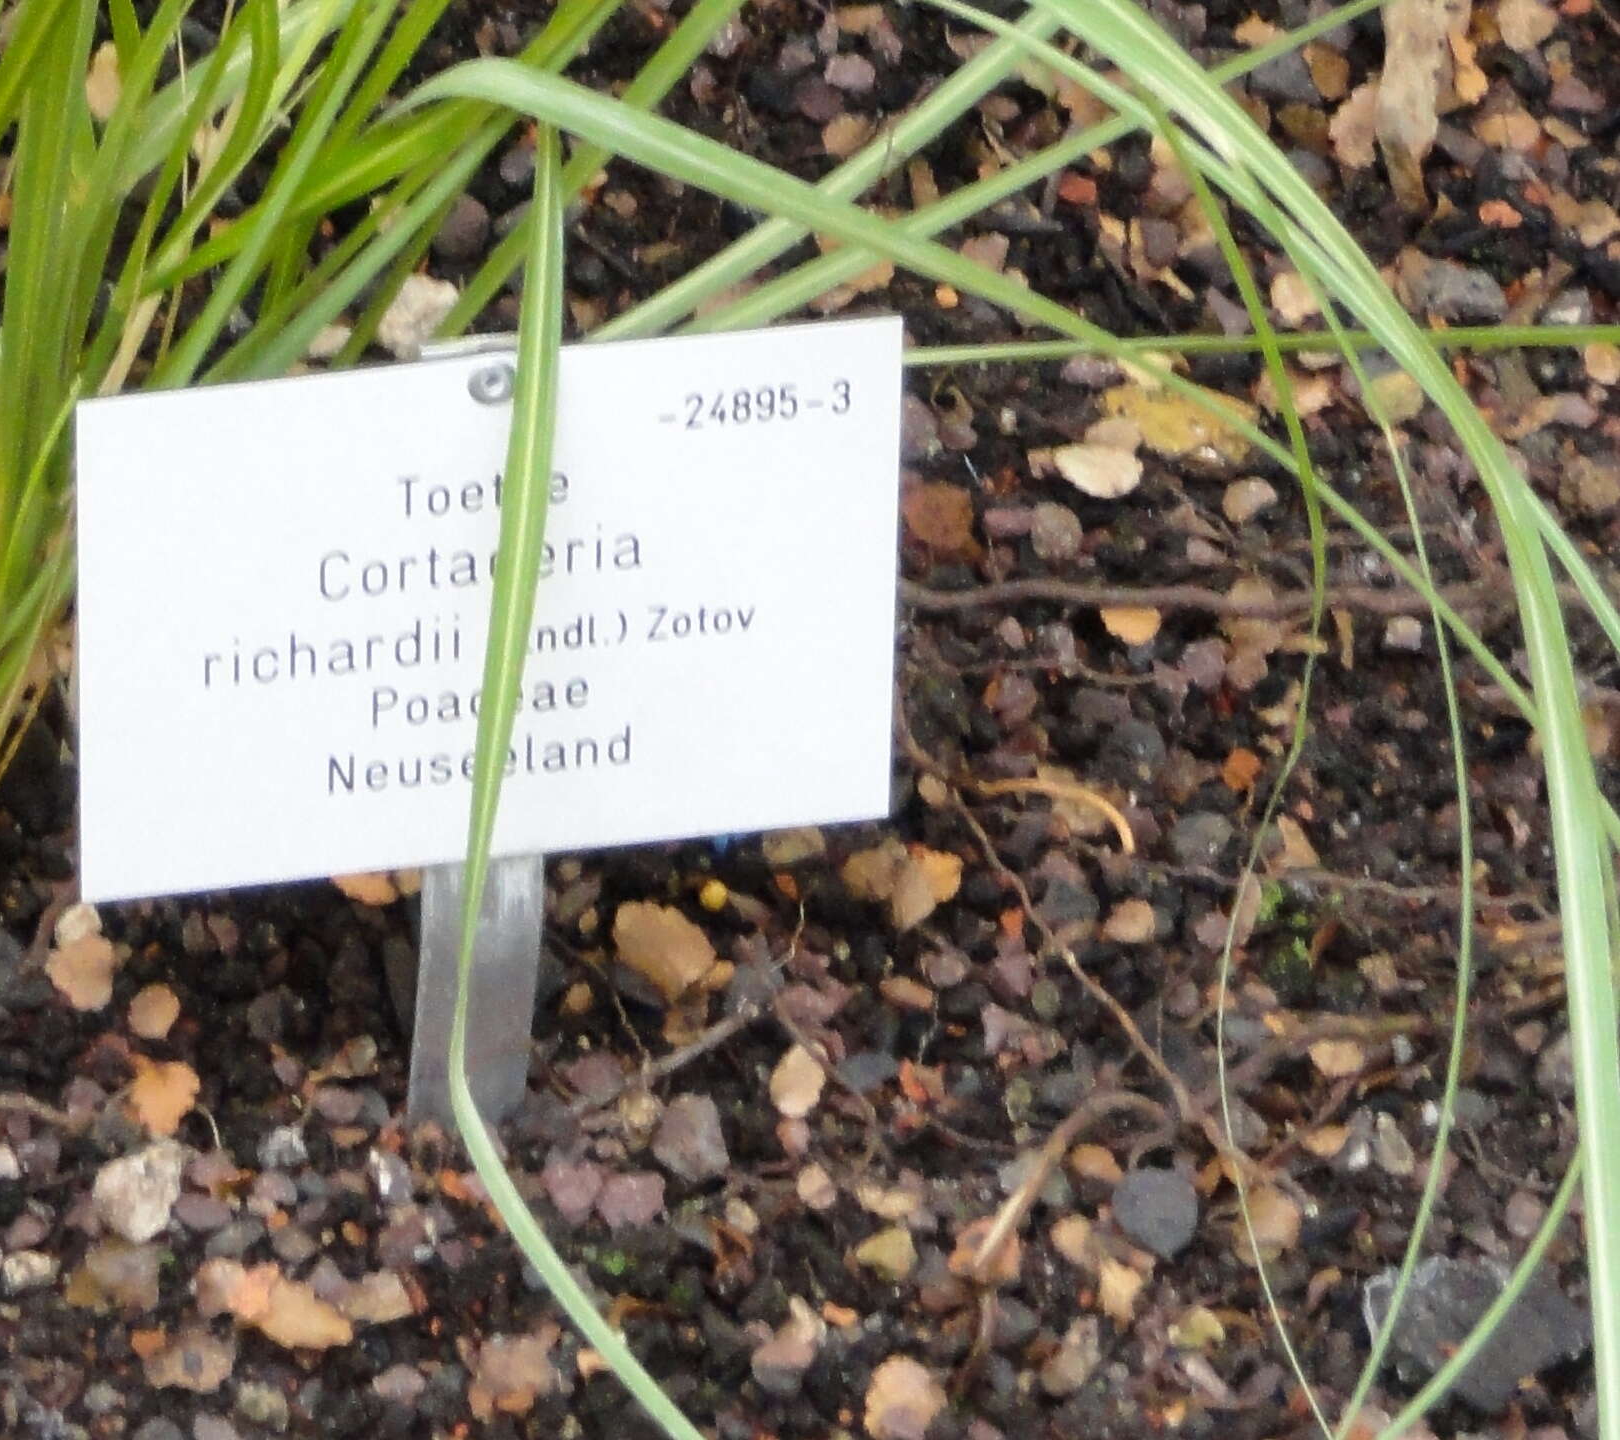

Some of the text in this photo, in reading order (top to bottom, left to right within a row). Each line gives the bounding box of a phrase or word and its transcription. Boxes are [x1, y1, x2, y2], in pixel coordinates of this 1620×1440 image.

[397, 470, 570, 519] Toete
[319, 523, 642, 602] Cortaeria
[204, 615, 462, 689] richardii
[647, 606, 755, 641] Zotov
